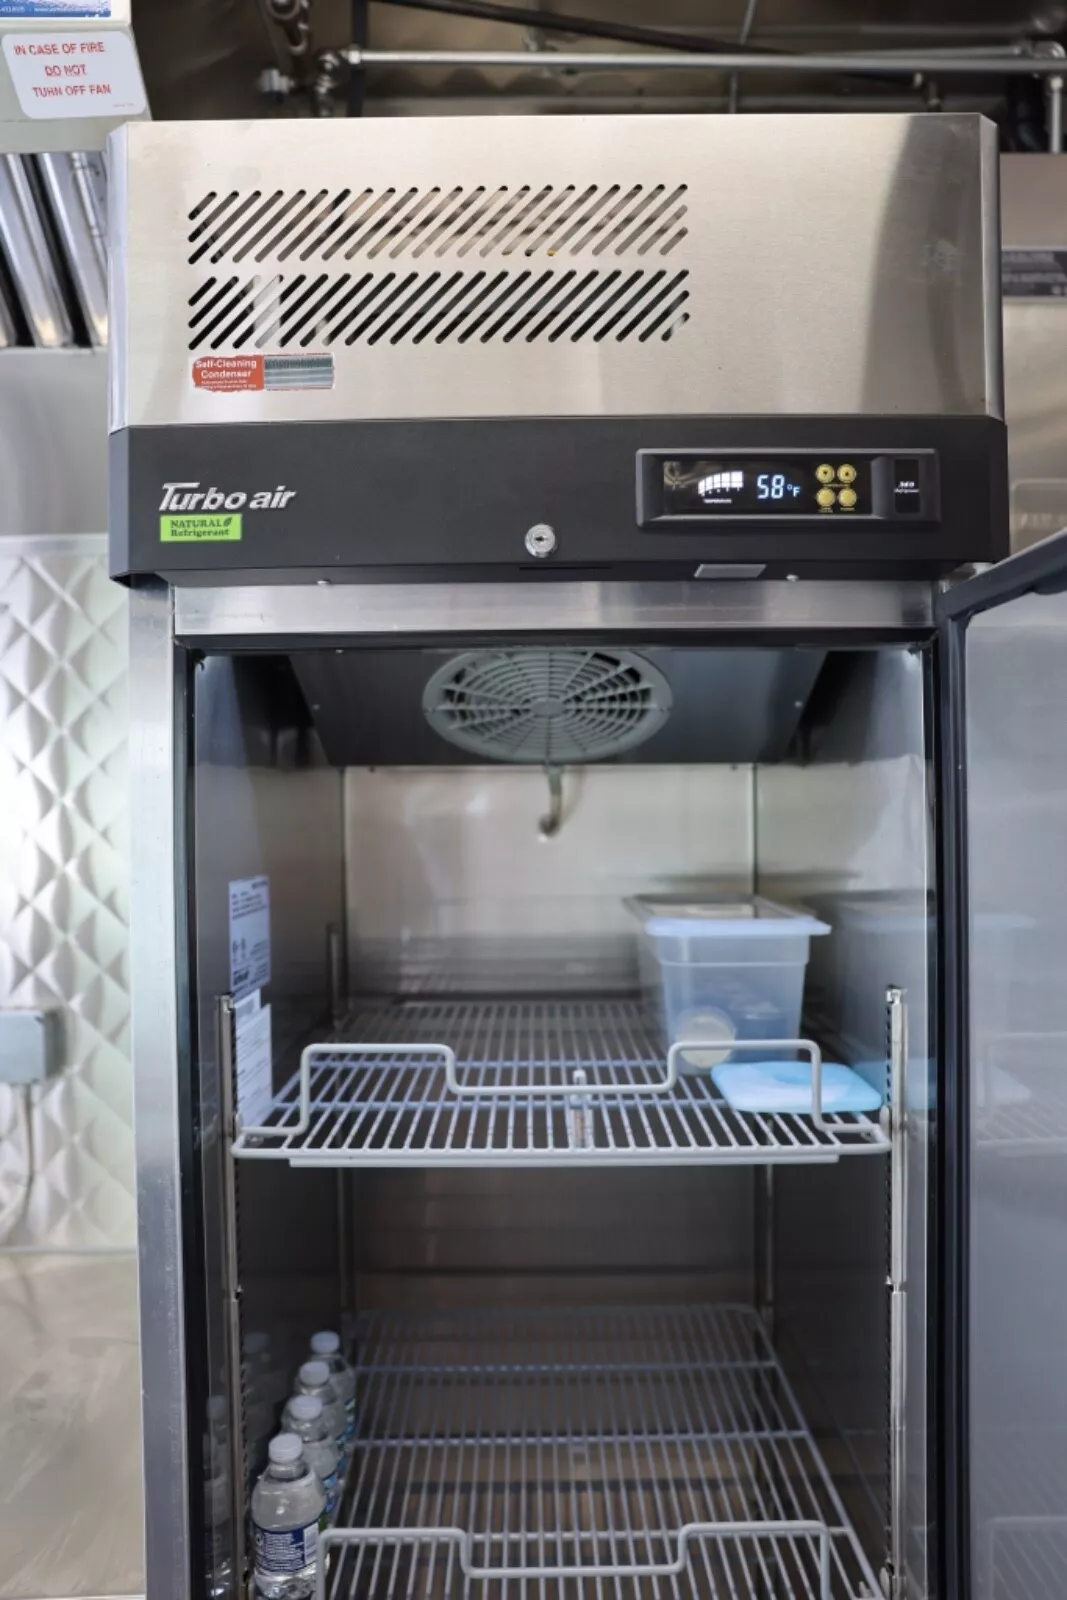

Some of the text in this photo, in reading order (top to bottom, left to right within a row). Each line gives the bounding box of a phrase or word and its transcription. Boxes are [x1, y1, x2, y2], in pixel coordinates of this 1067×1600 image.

[14, 42, 105, 55] IN CASE OF FIRE
[45, 64, 86, 76] DO NOT
[32, 84, 111, 97] TURN OFF FAN
[195, 359, 257, 369] Self-Cleaning
[201, 370, 251, 379] Condenser
[159, 482, 297, 511] Turbo air
[170, 519, 222, 528] NATURAL
[170, 529, 229, 538] Refrigerant
